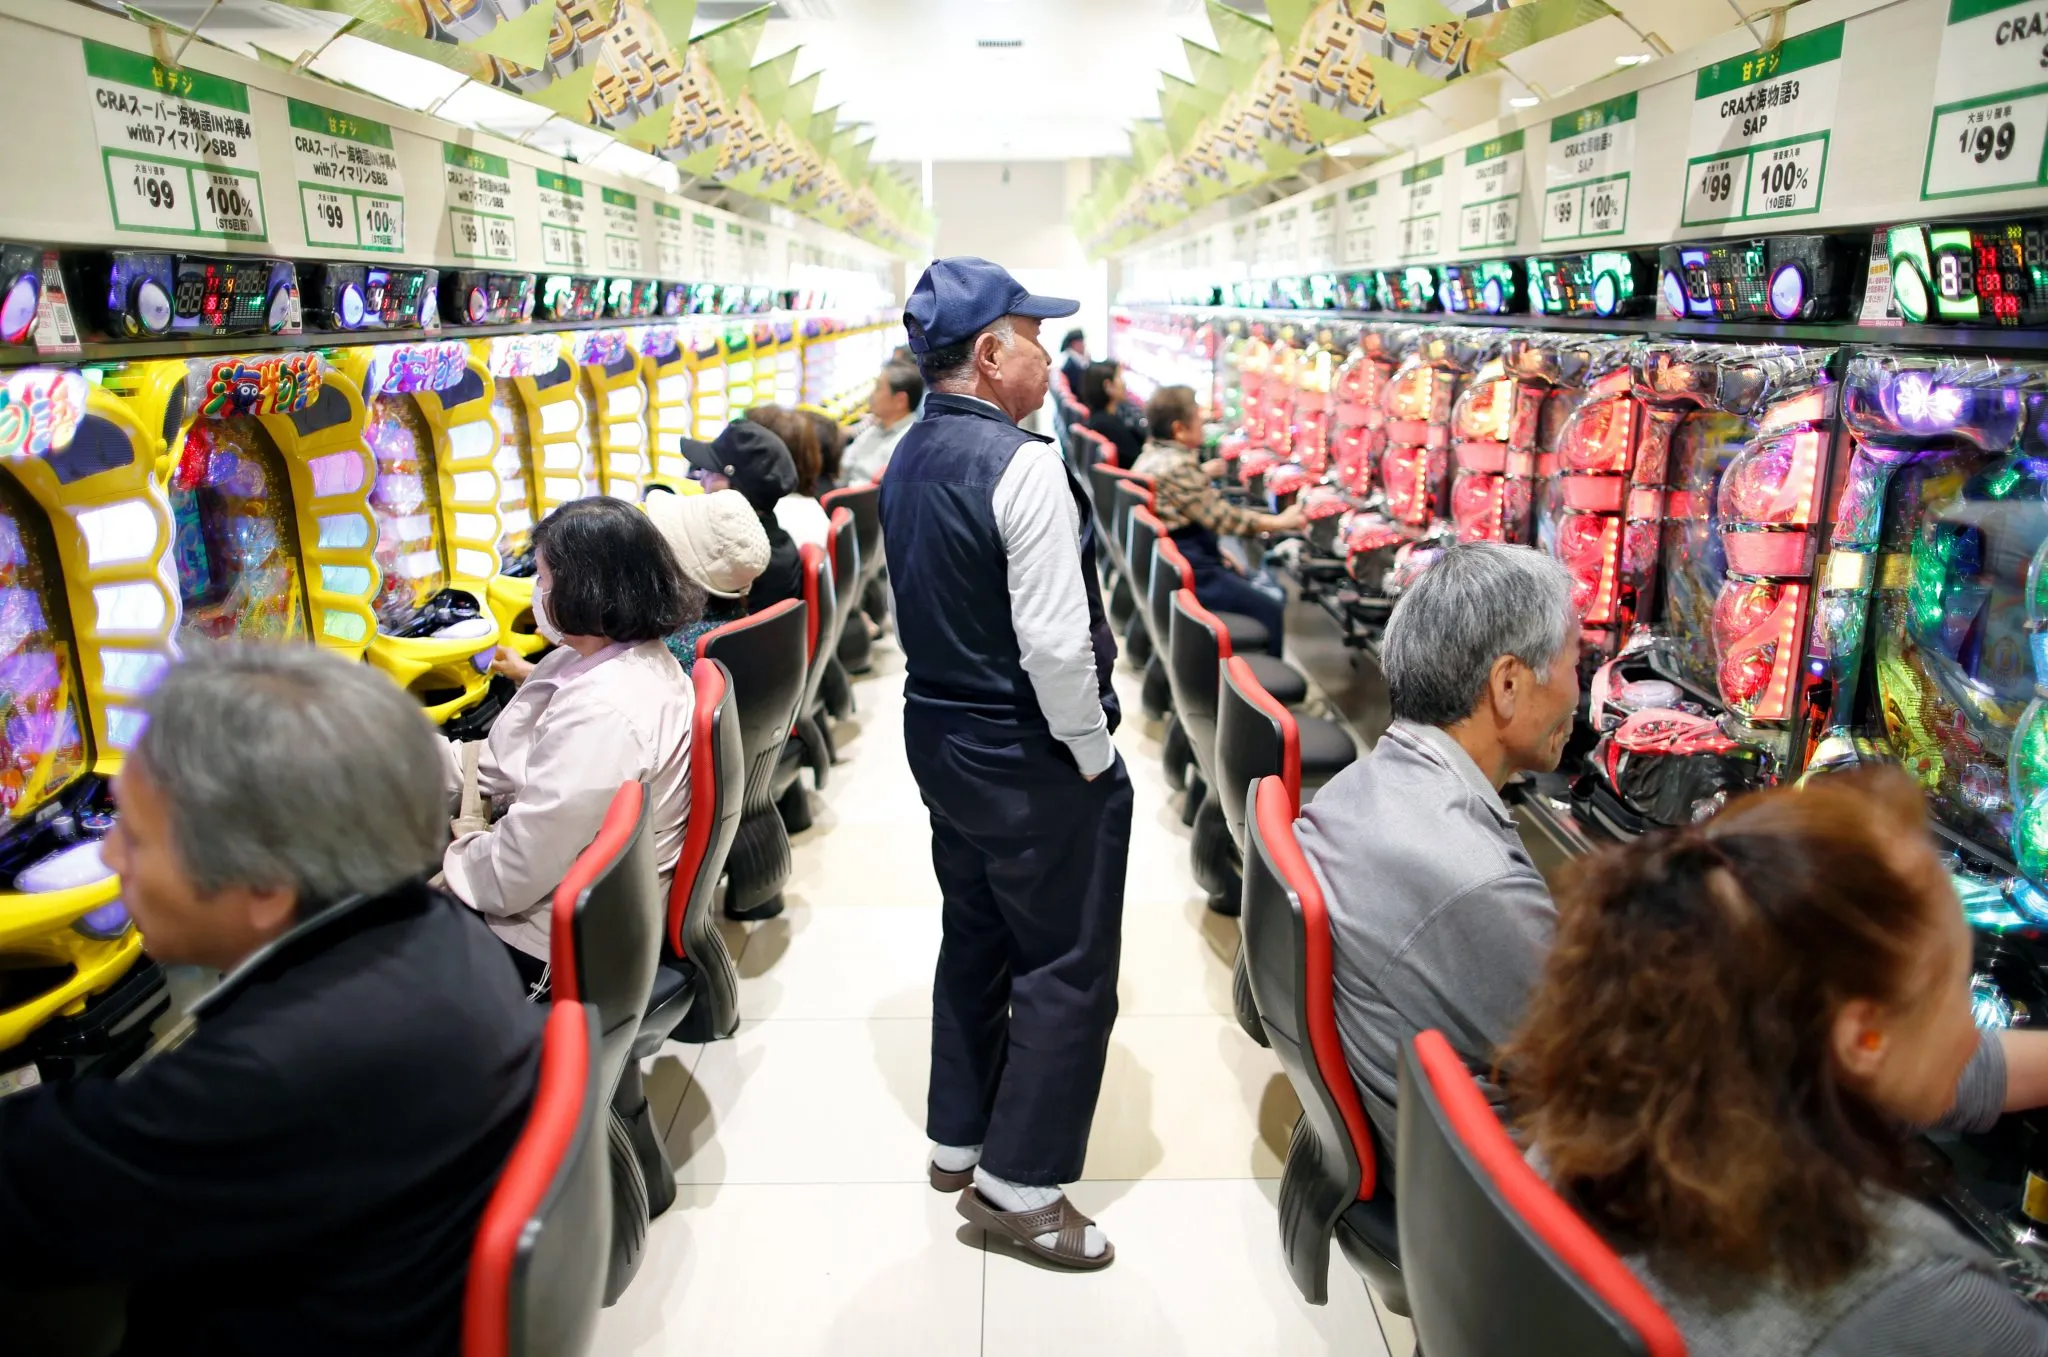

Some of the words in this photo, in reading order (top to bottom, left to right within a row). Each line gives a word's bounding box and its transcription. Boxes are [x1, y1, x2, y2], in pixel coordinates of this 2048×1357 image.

[1995, 12, 2048, 46] CRA
[1742, 53, 1779, 81] 甘デジ
[96, 88, 252, 140] CRAスーパー海物語IN沖縄4
[1721, 80, 1800, 118] CRA大海物語3
[127, 123, 237, 158] withアイマリンSBB
[1743, 115, 1768, 136] SAP
[1959, 121, 2016, 163] 1/99
[313, 161, 388, 186] withアイマリンSBB
[1702, 173, 1731, 202] 1/99
[1761, 161, 1809, 194] 100%
[133, 175, 175, 209] 1/99
[206, 186, 253, 218] 100%
[317, 203, 343, 229] 1/99
[367, 209, 396, 234] 100%
